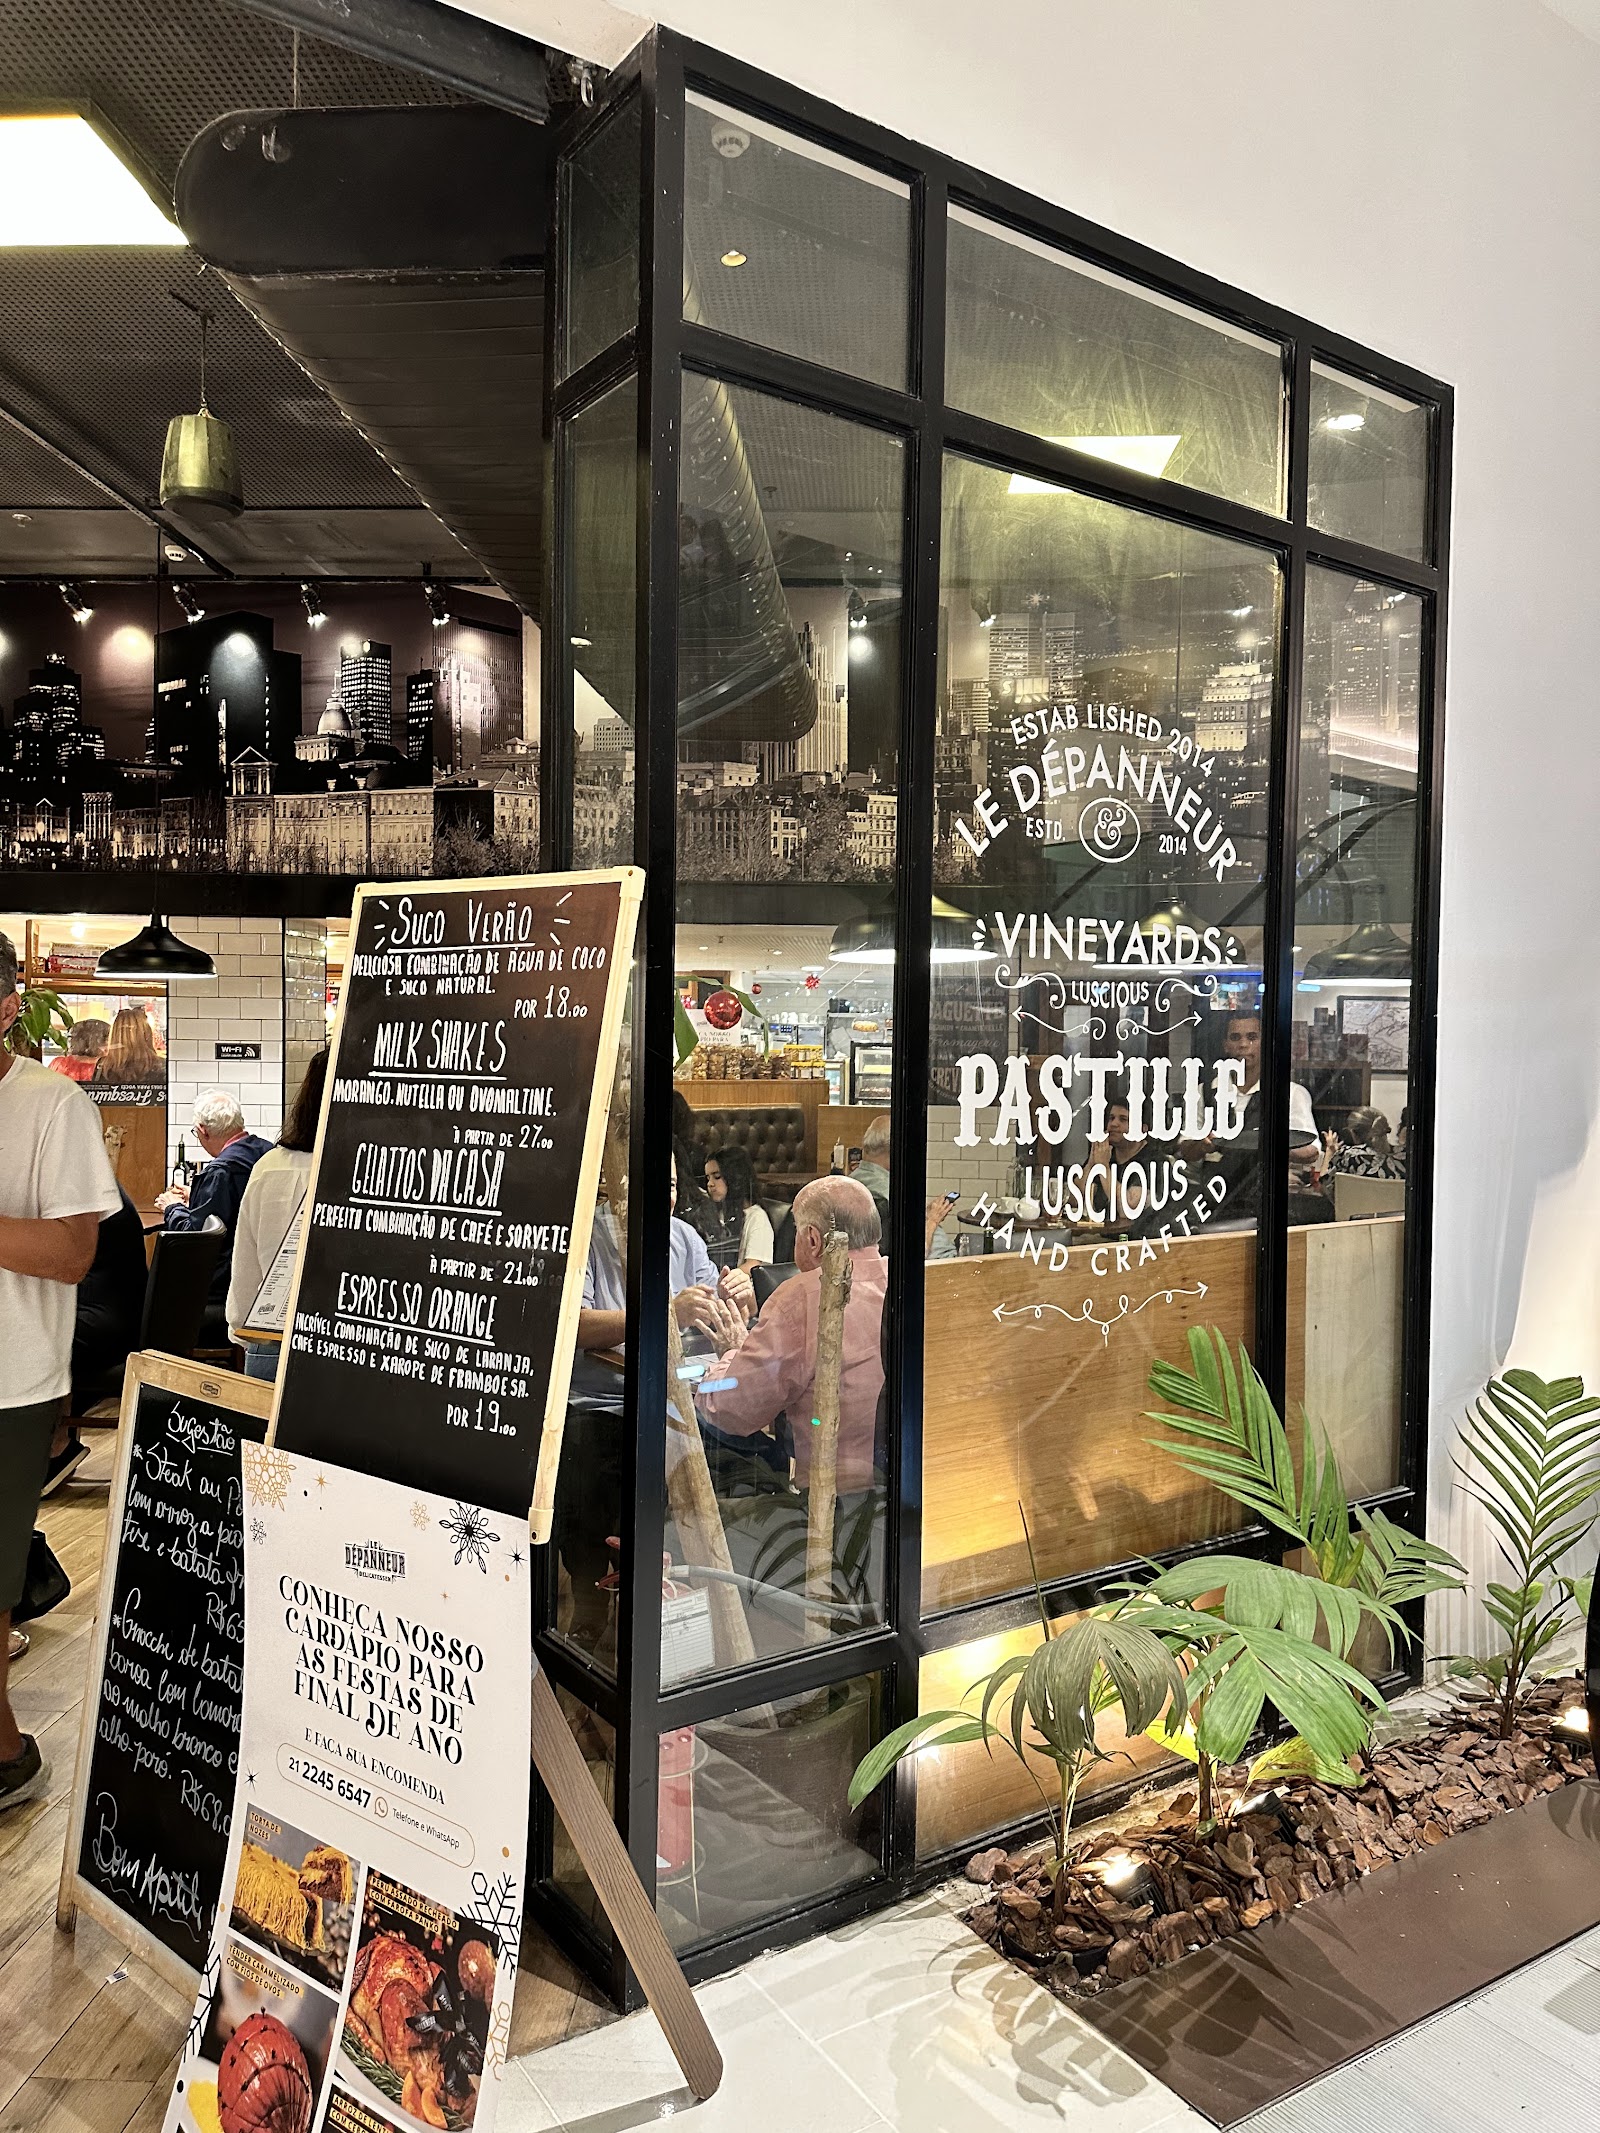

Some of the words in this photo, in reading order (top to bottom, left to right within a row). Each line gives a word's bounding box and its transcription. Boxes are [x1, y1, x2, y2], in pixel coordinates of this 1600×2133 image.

[1011, 707, 1079, 745] ESTAB
[1087, 704, 1162, 742] LISHED
[1167, 728, 1217, 778] 2014
[955, 787, 1009, 858] LE
[1009, 738, 1237, 883] DÉPANNEUR
[1026, 817, 1065, 841] ESTD.
[1158, 834, 1188, 855] 2014
[407, 948, 482, 977] COMBINAÇÃO
[486, 951, 500, 974] DE
[507, 946, 544, 973] ÁGUA
[548, 948, 564, 971] DE
[572, 948, 606, 970] COCO
[994, 911, 1223, 967] VINEYARDS
[385, 978, 393, 996] E
[399, 978, 428, 996] SUCO
[436, 975, 496, 995] NATURAL.
[514, 997, 537, 1019] POR
[1071, 980, 1150, 1009] LUSCIOUS
[373, 1021, 424, 1069] MILK
[426, 1019, 507, 1073] SHAKES
[448, 1084, 466, 1112] OU
[953, 1050, 1246, 1147] PASTILLE
[464, 1127, 496, 1147] PARTIR
[499, 1131, 514, 1149] DE
[351, 1142, 427, 1201] GELATTOS
[429, 1147, 450, 1204] DA
[452, 1150, 506, 1208] CASA
[1025, 1159, 1188, 1223] LUSCIOUS
[313, 1203, 362, 1231] PERFEITO
[364, 1208, 436, 1241] COMBINAÇÃO
[440, 1218, 457, 1241] DE
[460, 1217, 493, 1246] CAFÉ
[495, 1225, 504, 1247] E
[970, 1191, 1069, 1273] HAND
[1091, 1175, 1227, 1276] CRAFTED
[440, 1257, 475, 1279] PARTIR
[479, 1265, 494, 1283] DE
[337, 1271, 424, 1326] ESPRESSO
[427, 1286, 498, 1340] ORANGE
[291, 1333, 314, 1354] CAFÉ
[316, 1339, 366, 1366] ESPRESSO
[369, 1352, 377, 1368] E
[380, 1354, 426, 1381] XAROPE
[430, 1364, 445, 1386] DE
[295, 1311, 331, 1337] INCRÍVEL
[333, 1320, 402, 1351] COMBINAÇÃO
[404, 1334, 419, 1356] DE
[424, 1337, 450, 1361] SUCO
[455, 1345, 470, 1365] DE
[446, 1403, 469, 1428] POR
[145, 1441, 192, 1491] Steak
[199, 1476, 222, 1504] au
[345, 1543, 405, 1575] DÉPANNEUR
[370, 1540, 378, 1549] LE
[177, 1623, 199, 1668] de
[279, 1575, 388, 1639] CONHEÇA
[395, 1616, 484, 1673] NOSSO
[285, 1607, 401, 1673] CARDÁPIO
[408, 1653, 476, 1706] PARA
[296, 1641, 325, 1674] AS
[332, 1654, 422, 1715] FESTAS
[430, 1694, 463, 1734] DE
[294, 1668, 360, 1722] FINAL
[365, 1700, 401, 1740] DE
[408, 1721, 463, 1765] ANO
[289, 1756, 300, 1773] 21
[302, 1761, 334, 1792] 2245
[337, 1779, 371, 1809] 6547
[305, 1727, 311, 1742] E
[315, 1732, 343, 1757] FAÇA
[346, 1747, 368, 1769] SUA
[370, 1757, 445, 1805] ENCOMENDA
[250, 1824, 269, 1840] NOZES
[251, 1812, 270, 1828] TORTA
[270, 1822, 279, 1833] DE
[392, 1807, 420, 1829] Telefone
[420, 1824, 425, 1832] e
[426, 1825, 460, 1850] WhatsApp
[370, 1890, 386, 1904] COM
[388, 1899, 413, 1918] FAROFA
[415, 1914, 439, 1933] PANKO
[372, 1877, 390, 1892] PERU
[390, 1888, 418, 1907] ASSADO
[419, 1902, 457, 1929] RECHEADO
[226, 1957, 240, 1970] COM
[240, 1966, 254, 1980] FIOS
[255, 1976, 263, 1986] DE
[263, 1981, 280, 1997] OVOS
[229, 1944, 251, 1964] TENDER
[252, 1960, 300, 1994] CARAMELIZADO
[331, 2109, 347, 2126] COM
[333, 2094, 357, 2115] ARROZ
[358, 2112, 368, 2123] DE
